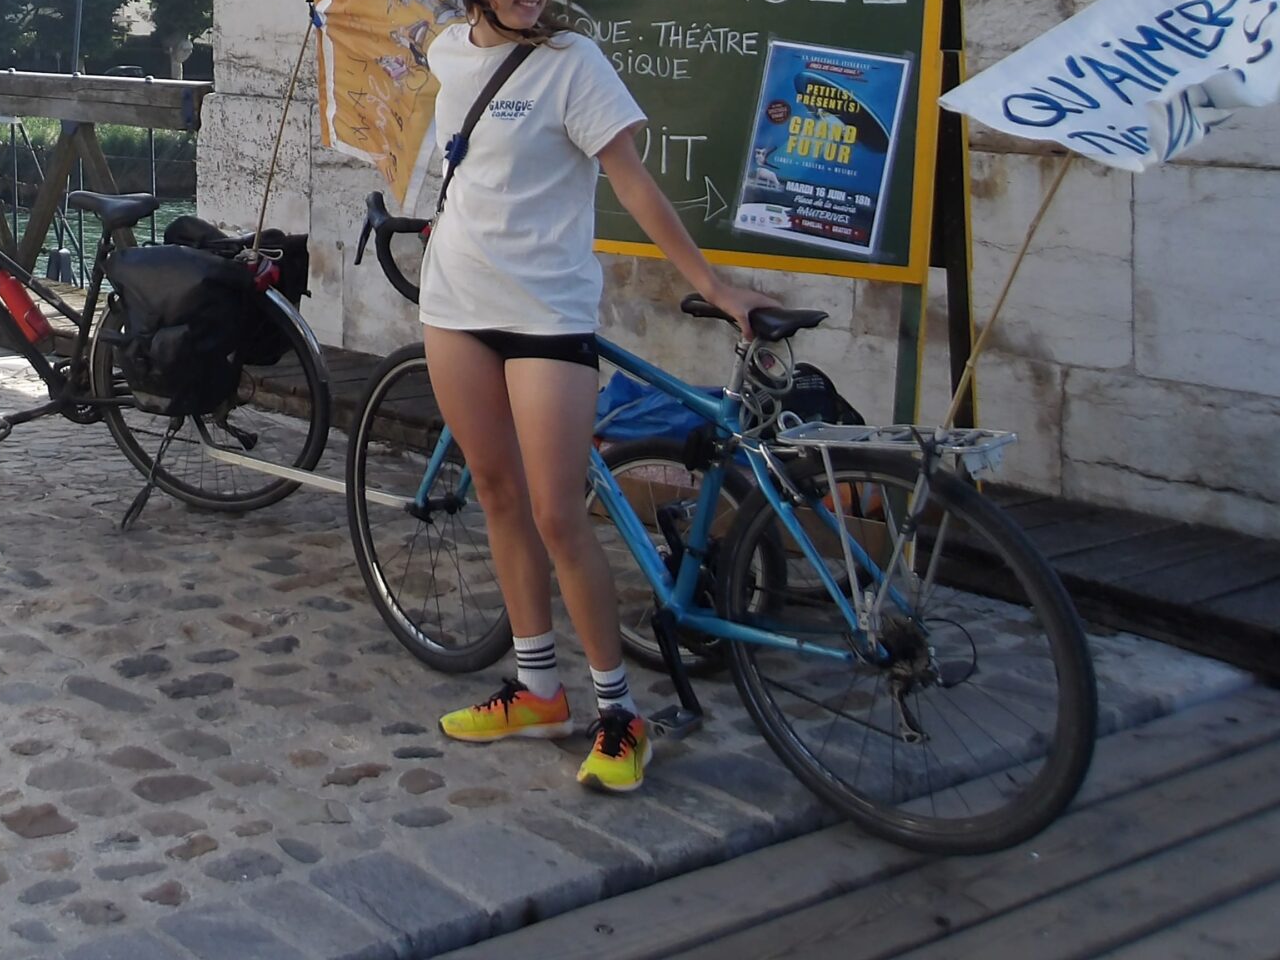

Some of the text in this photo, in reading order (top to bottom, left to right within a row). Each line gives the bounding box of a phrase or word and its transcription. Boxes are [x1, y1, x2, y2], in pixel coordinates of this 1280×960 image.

[651, 20, 759, 56] THÉÂTRE
[806, 84, 854, 100] PETIT(S)
[489, 100, 535, 112] GARRIGUE
[788, 116, 857, 144] GRAND
[786, 135, 851, 164] FUTUR
[785, 181, 814, 195] MARDI
[827, 188, 846, 201] JUIN
[796, 206, 850, 224] HAUTERIVES
